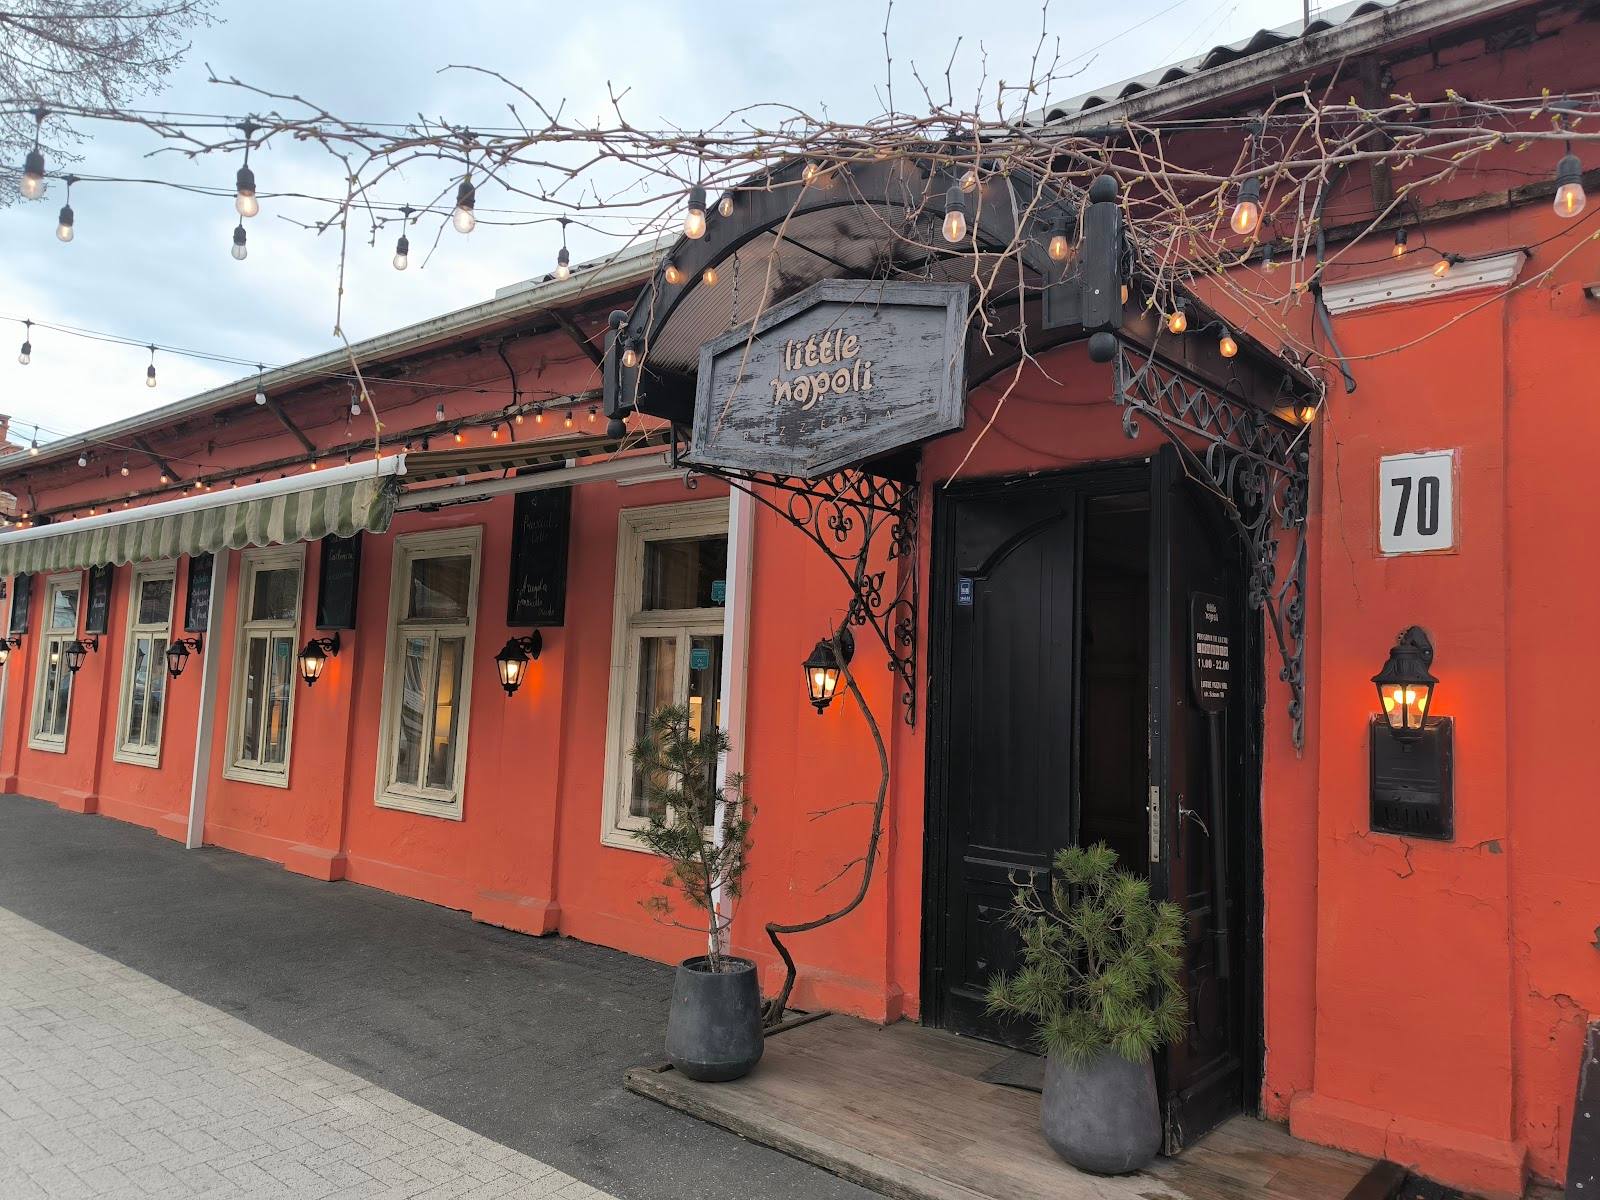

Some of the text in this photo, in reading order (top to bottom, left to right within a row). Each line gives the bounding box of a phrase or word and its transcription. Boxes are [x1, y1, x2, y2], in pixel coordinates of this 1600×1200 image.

[784, 328, 861, 371] little
[770, 358, 873, 411] napoli
[1391, 475, 1440, 536] 70
